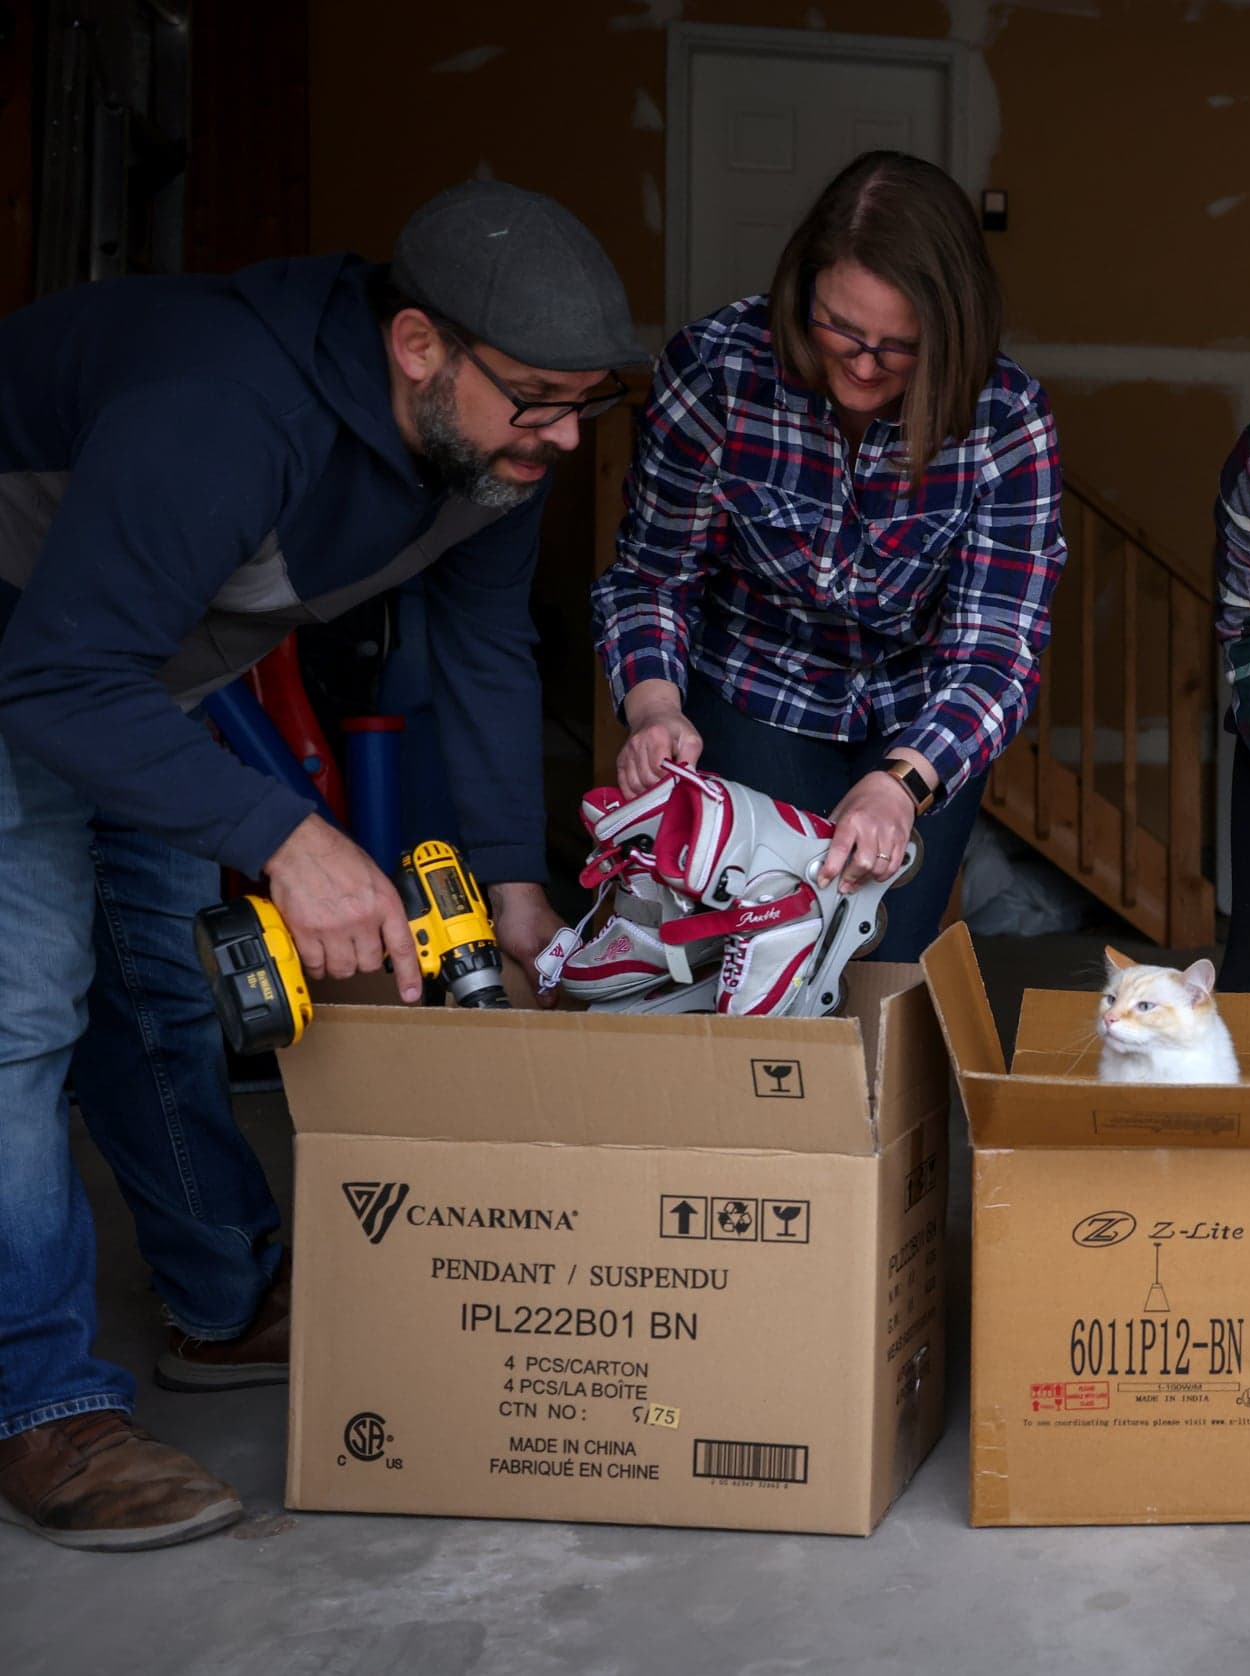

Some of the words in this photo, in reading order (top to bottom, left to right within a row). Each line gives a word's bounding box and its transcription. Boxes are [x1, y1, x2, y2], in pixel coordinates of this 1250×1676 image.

[405, 1204, 574, 1231] CANARMNA
[1148, 1221, 1245, 1241] Z-Lite
[431, 1256, 556, 1285] PENDANT
[589, 1265, 729, 1290] SUSPENDU
[460, 1302, 634, 1340] IPL222B01
[650, 1311, 698, 1341] BN
[1070, 1317, 1245, 1377] 6011P12-BN
[503, 1355, 515, 1371] 4
[525, 1356, 649, 1378] PCS/CARTON
[503, 1378, 515, 1394] 4
[519, 1378, 587, 1397] PCS/LA
[591, 1379, 648, 1401] BOÎTE
[1135, 1394, 1159, 1403] MADE
[1164, 1394, 1176, 1403] IN
[1181, 1395, 1210, 1403] INDIA
[498, 1400, 537, 1419] CTN
[509, 1436, 558, 1454] MADE
[562, 1439, 580, 1455] IN
[583, 1439, 637, 1457] CHINA
[385, 1457, 404, 1470] US
[489, 1457, 574, 1477] FABRIQUÉ
[579, 1462, 603, 1479] EN
[606, 1464, 660, 1481] CHINE
